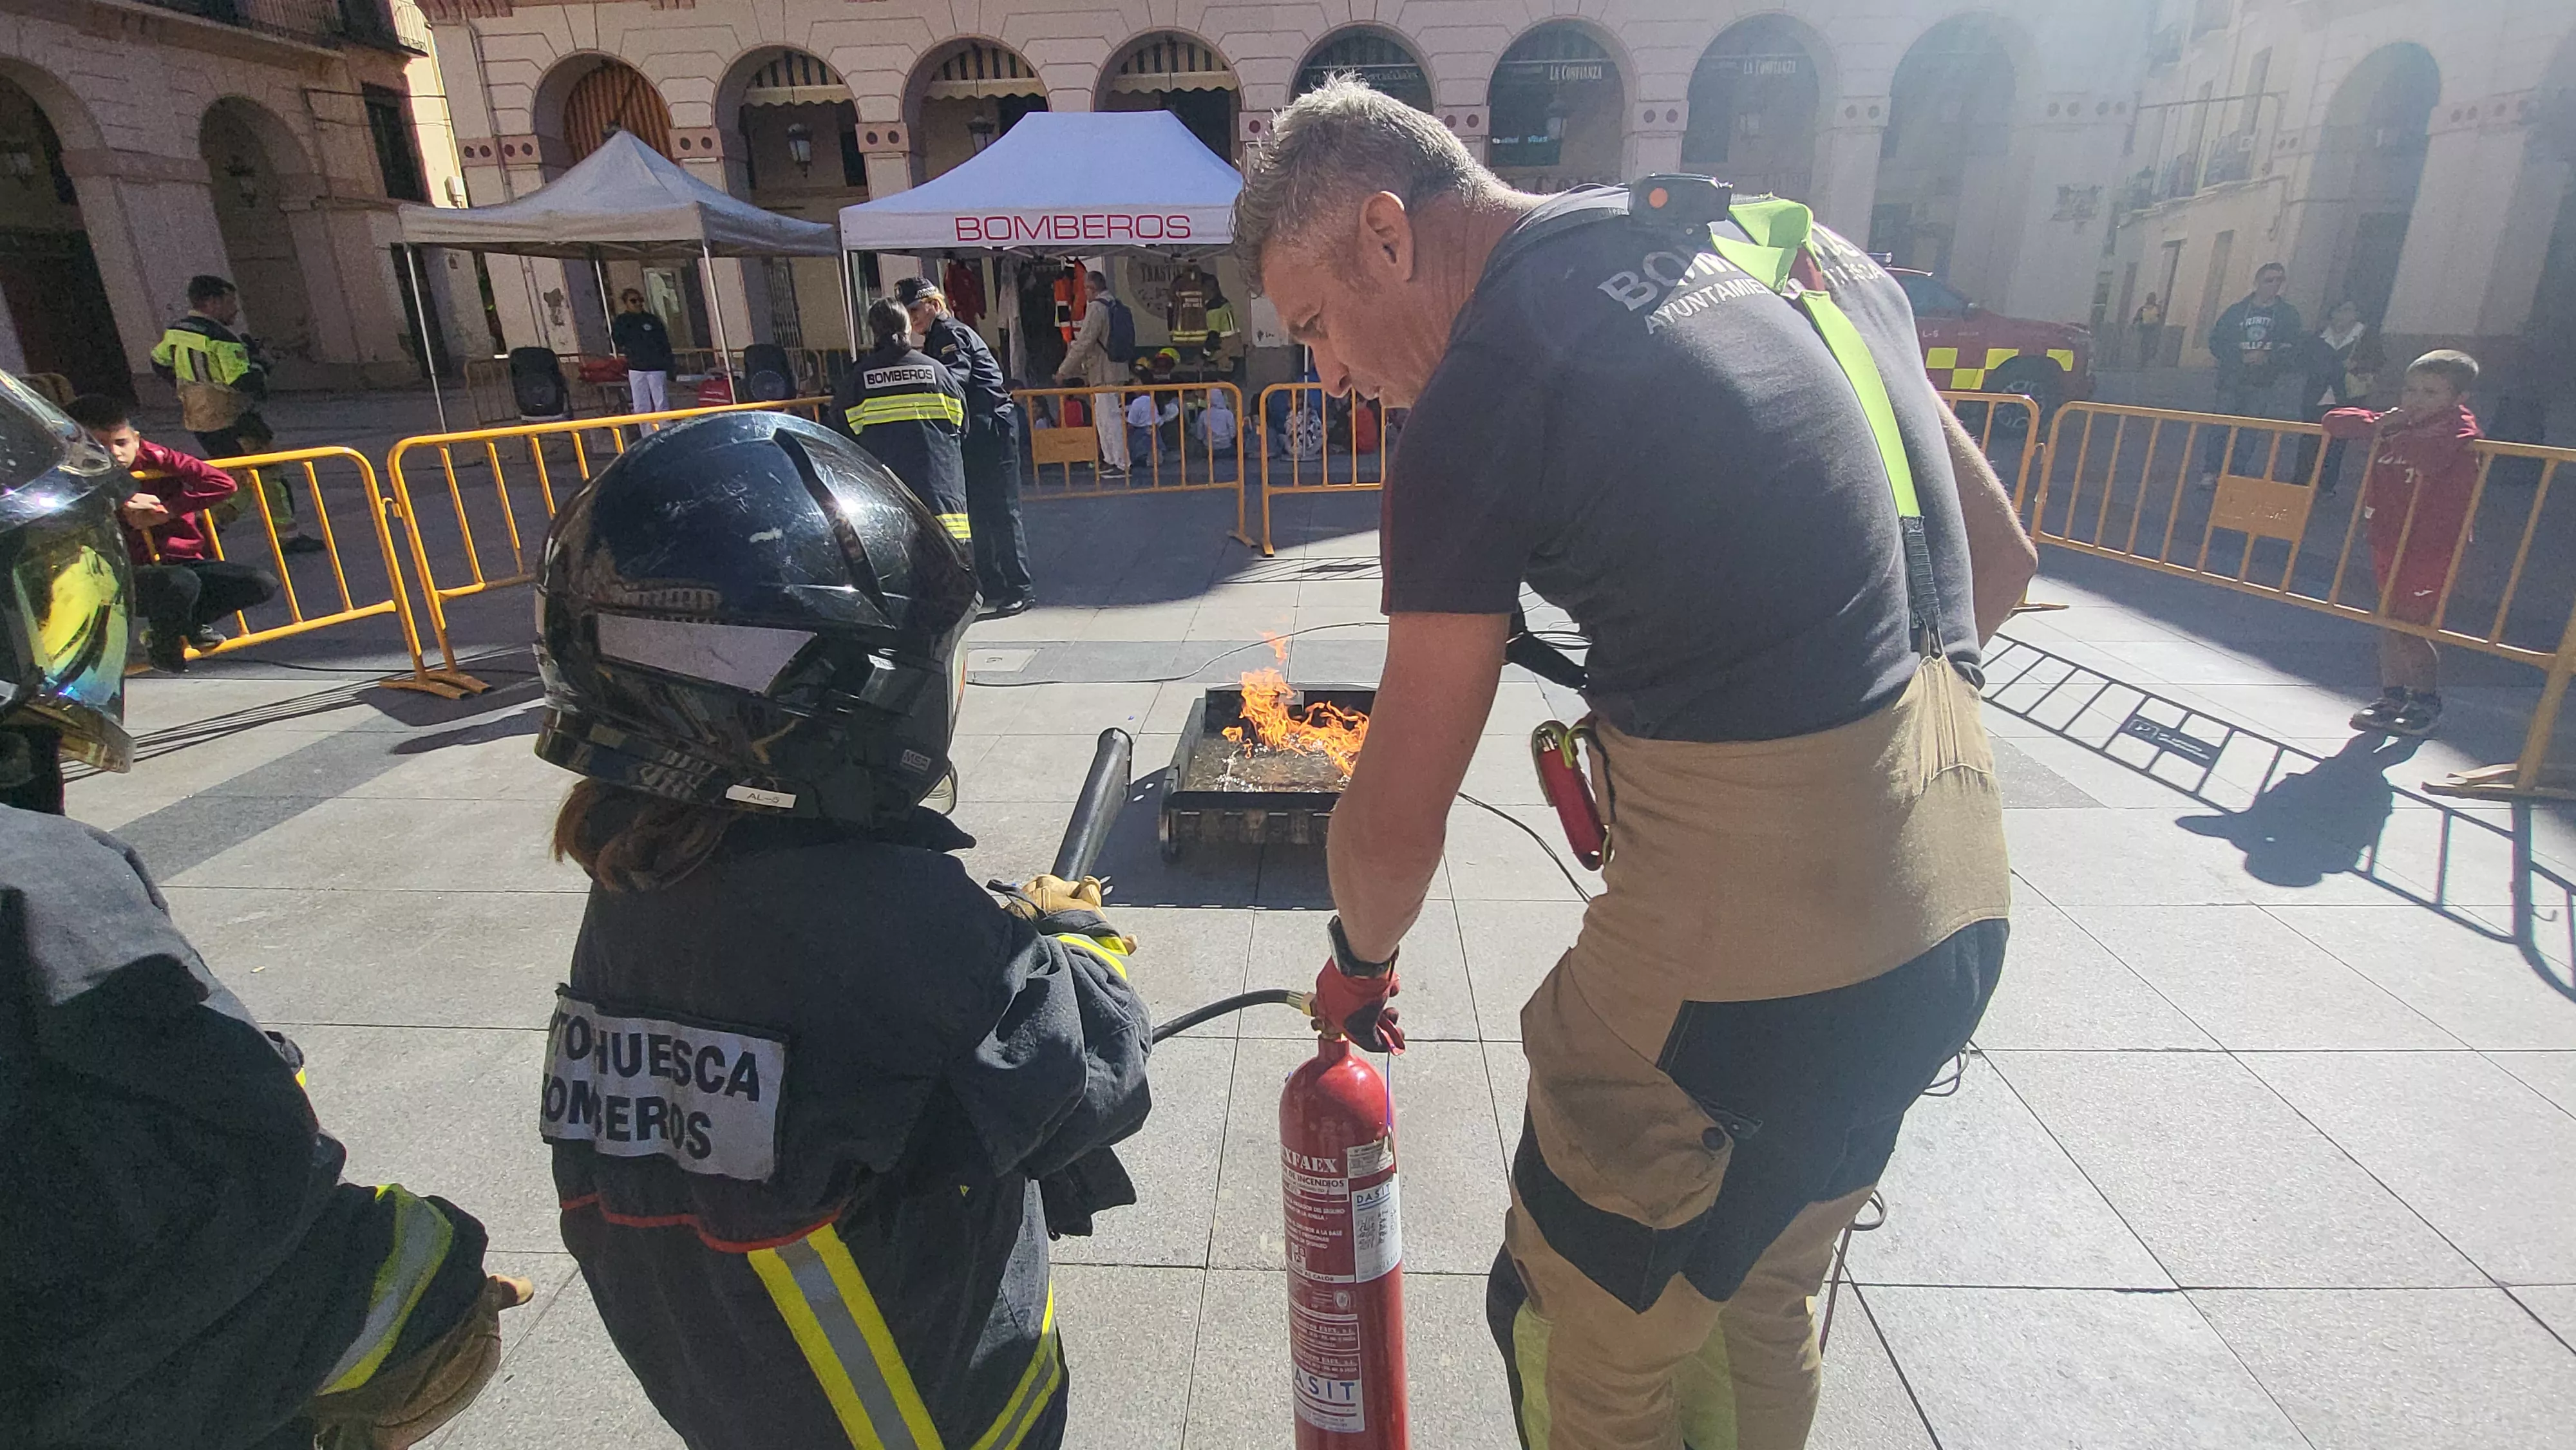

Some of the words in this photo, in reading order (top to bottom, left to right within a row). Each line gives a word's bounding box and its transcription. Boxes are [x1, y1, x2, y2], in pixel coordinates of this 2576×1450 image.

[955, 214, 1191, 241] BOMBEROS
[867, 369, 933, 384] BOMBEROS
[1297, 1174, 1345, 1188] INCENDIOS
[1356, 1183, 1390, 1204] DASIT
[1294, 1366, 1356, 1401] ASIT
